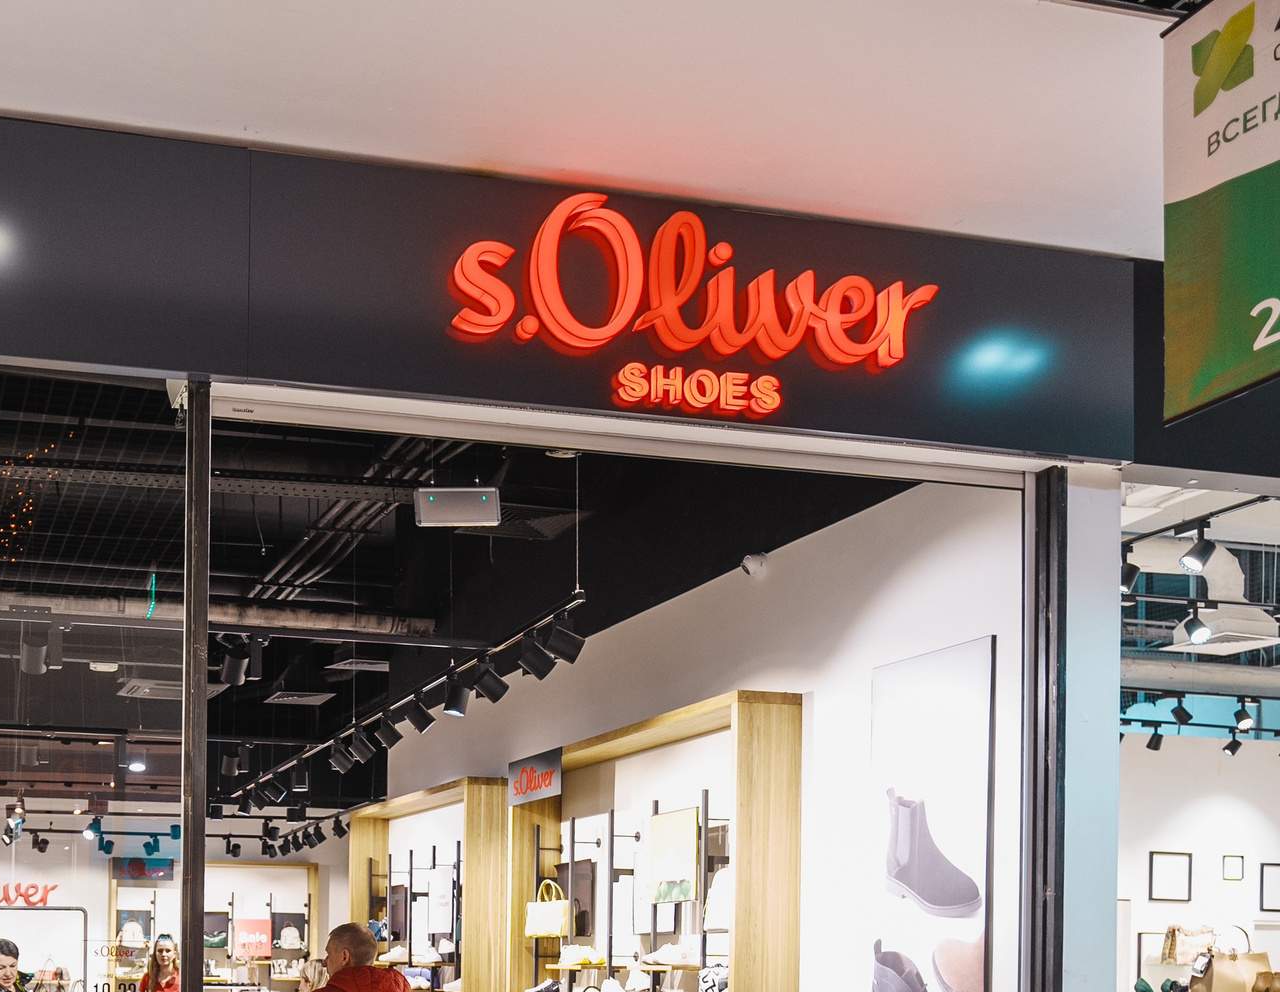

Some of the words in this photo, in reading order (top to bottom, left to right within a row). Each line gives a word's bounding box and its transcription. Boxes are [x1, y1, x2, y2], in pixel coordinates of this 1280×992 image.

[450, 192, 939, 368] s.Oliver
[616, 362, 782, 415] SHOES
[513, 766, 555, 796] s.Oliver
